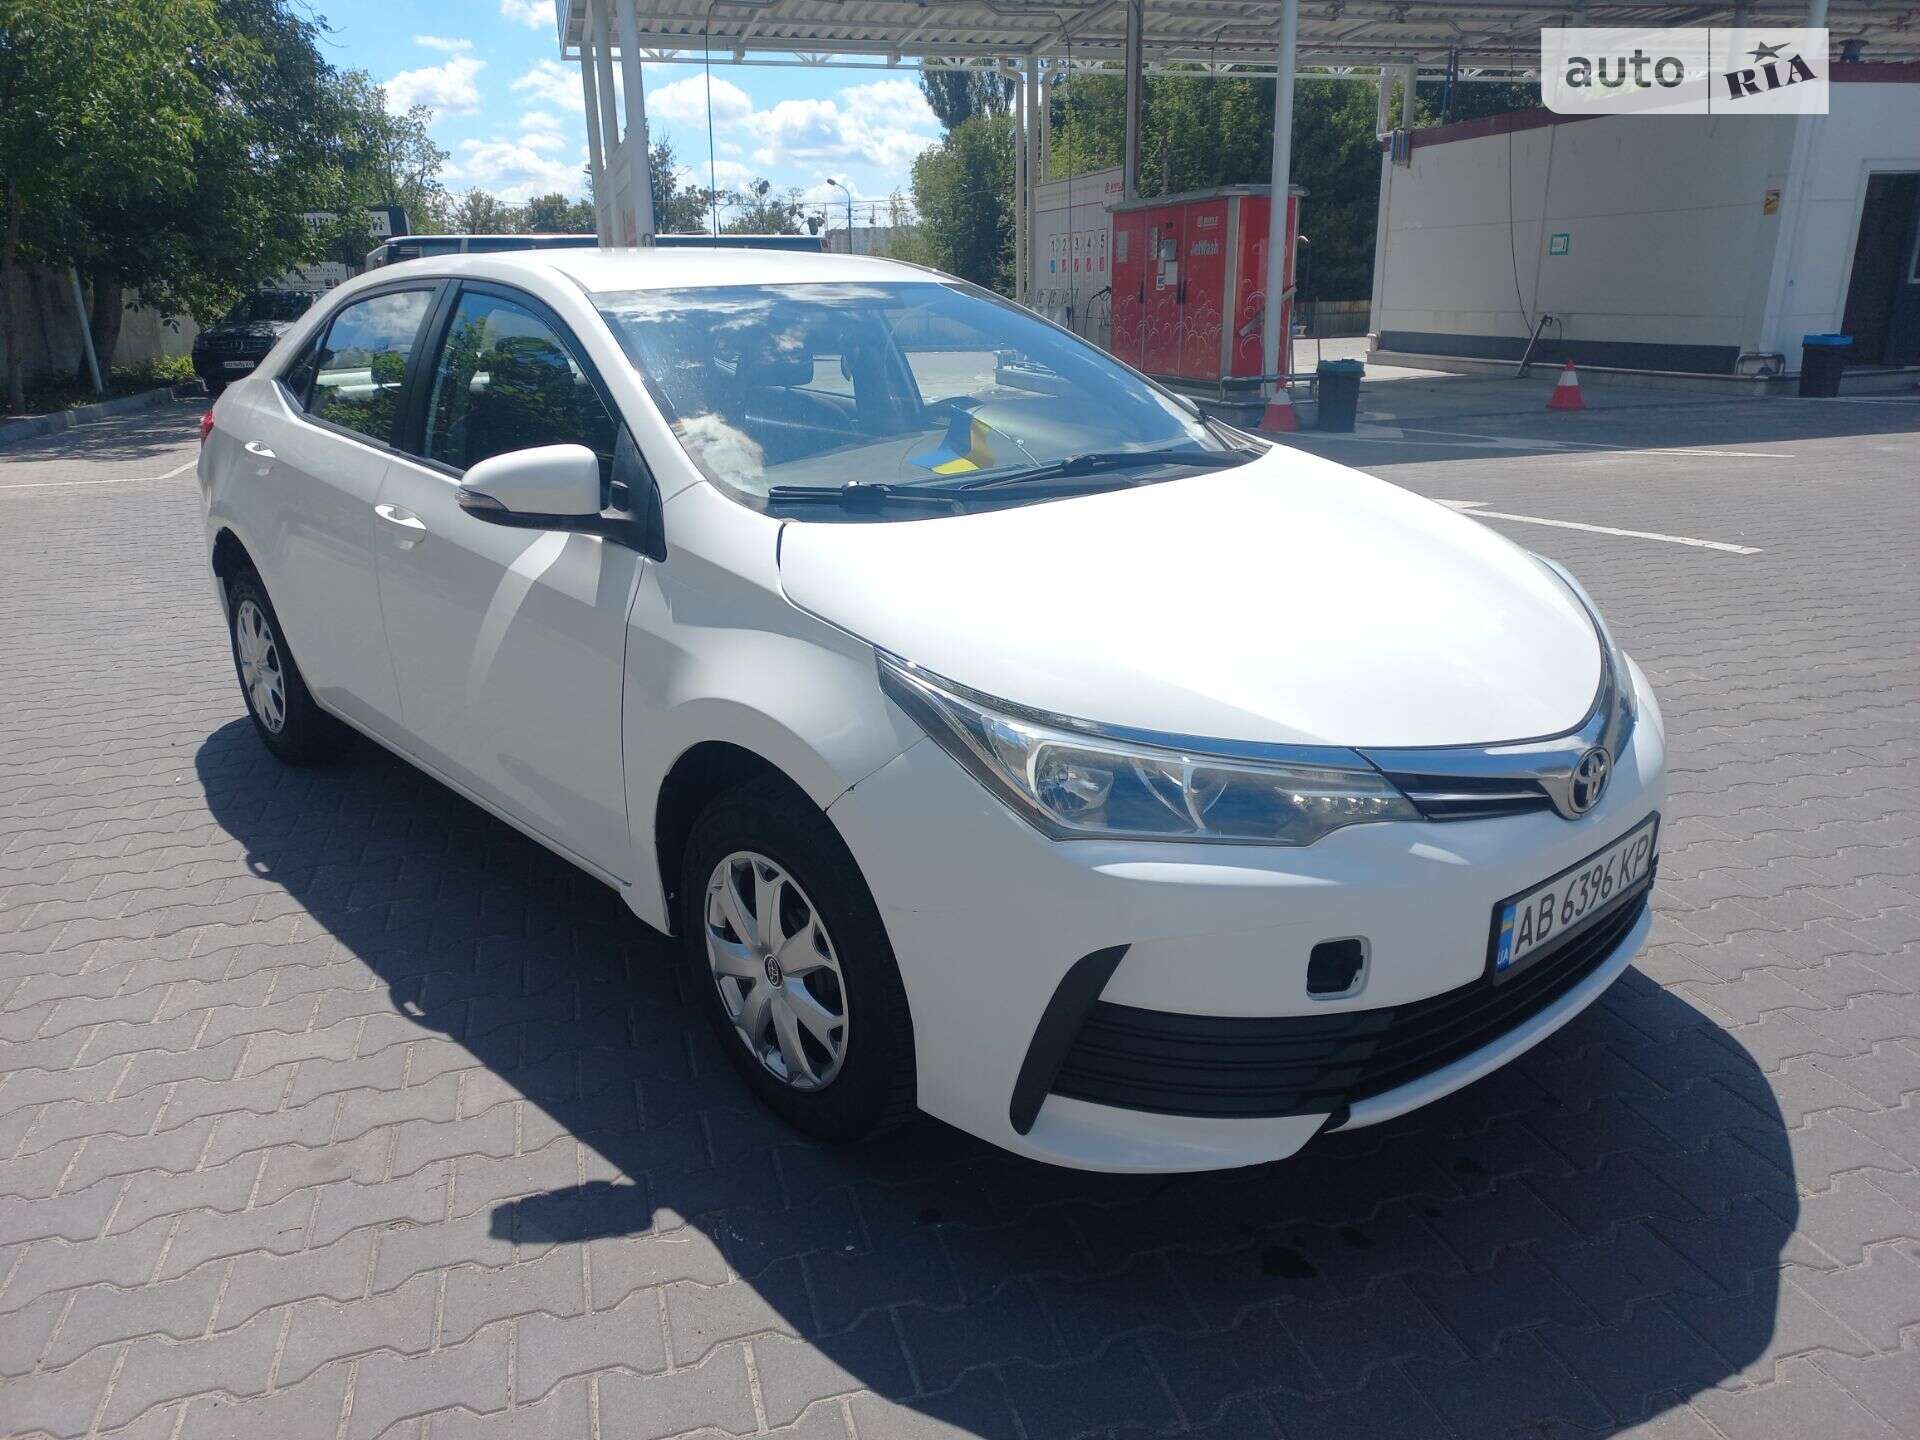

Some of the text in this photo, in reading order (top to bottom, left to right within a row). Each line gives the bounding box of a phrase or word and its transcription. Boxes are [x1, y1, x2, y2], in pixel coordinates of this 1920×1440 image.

[1515, 833, 1649, 954] AB 6396 KP
